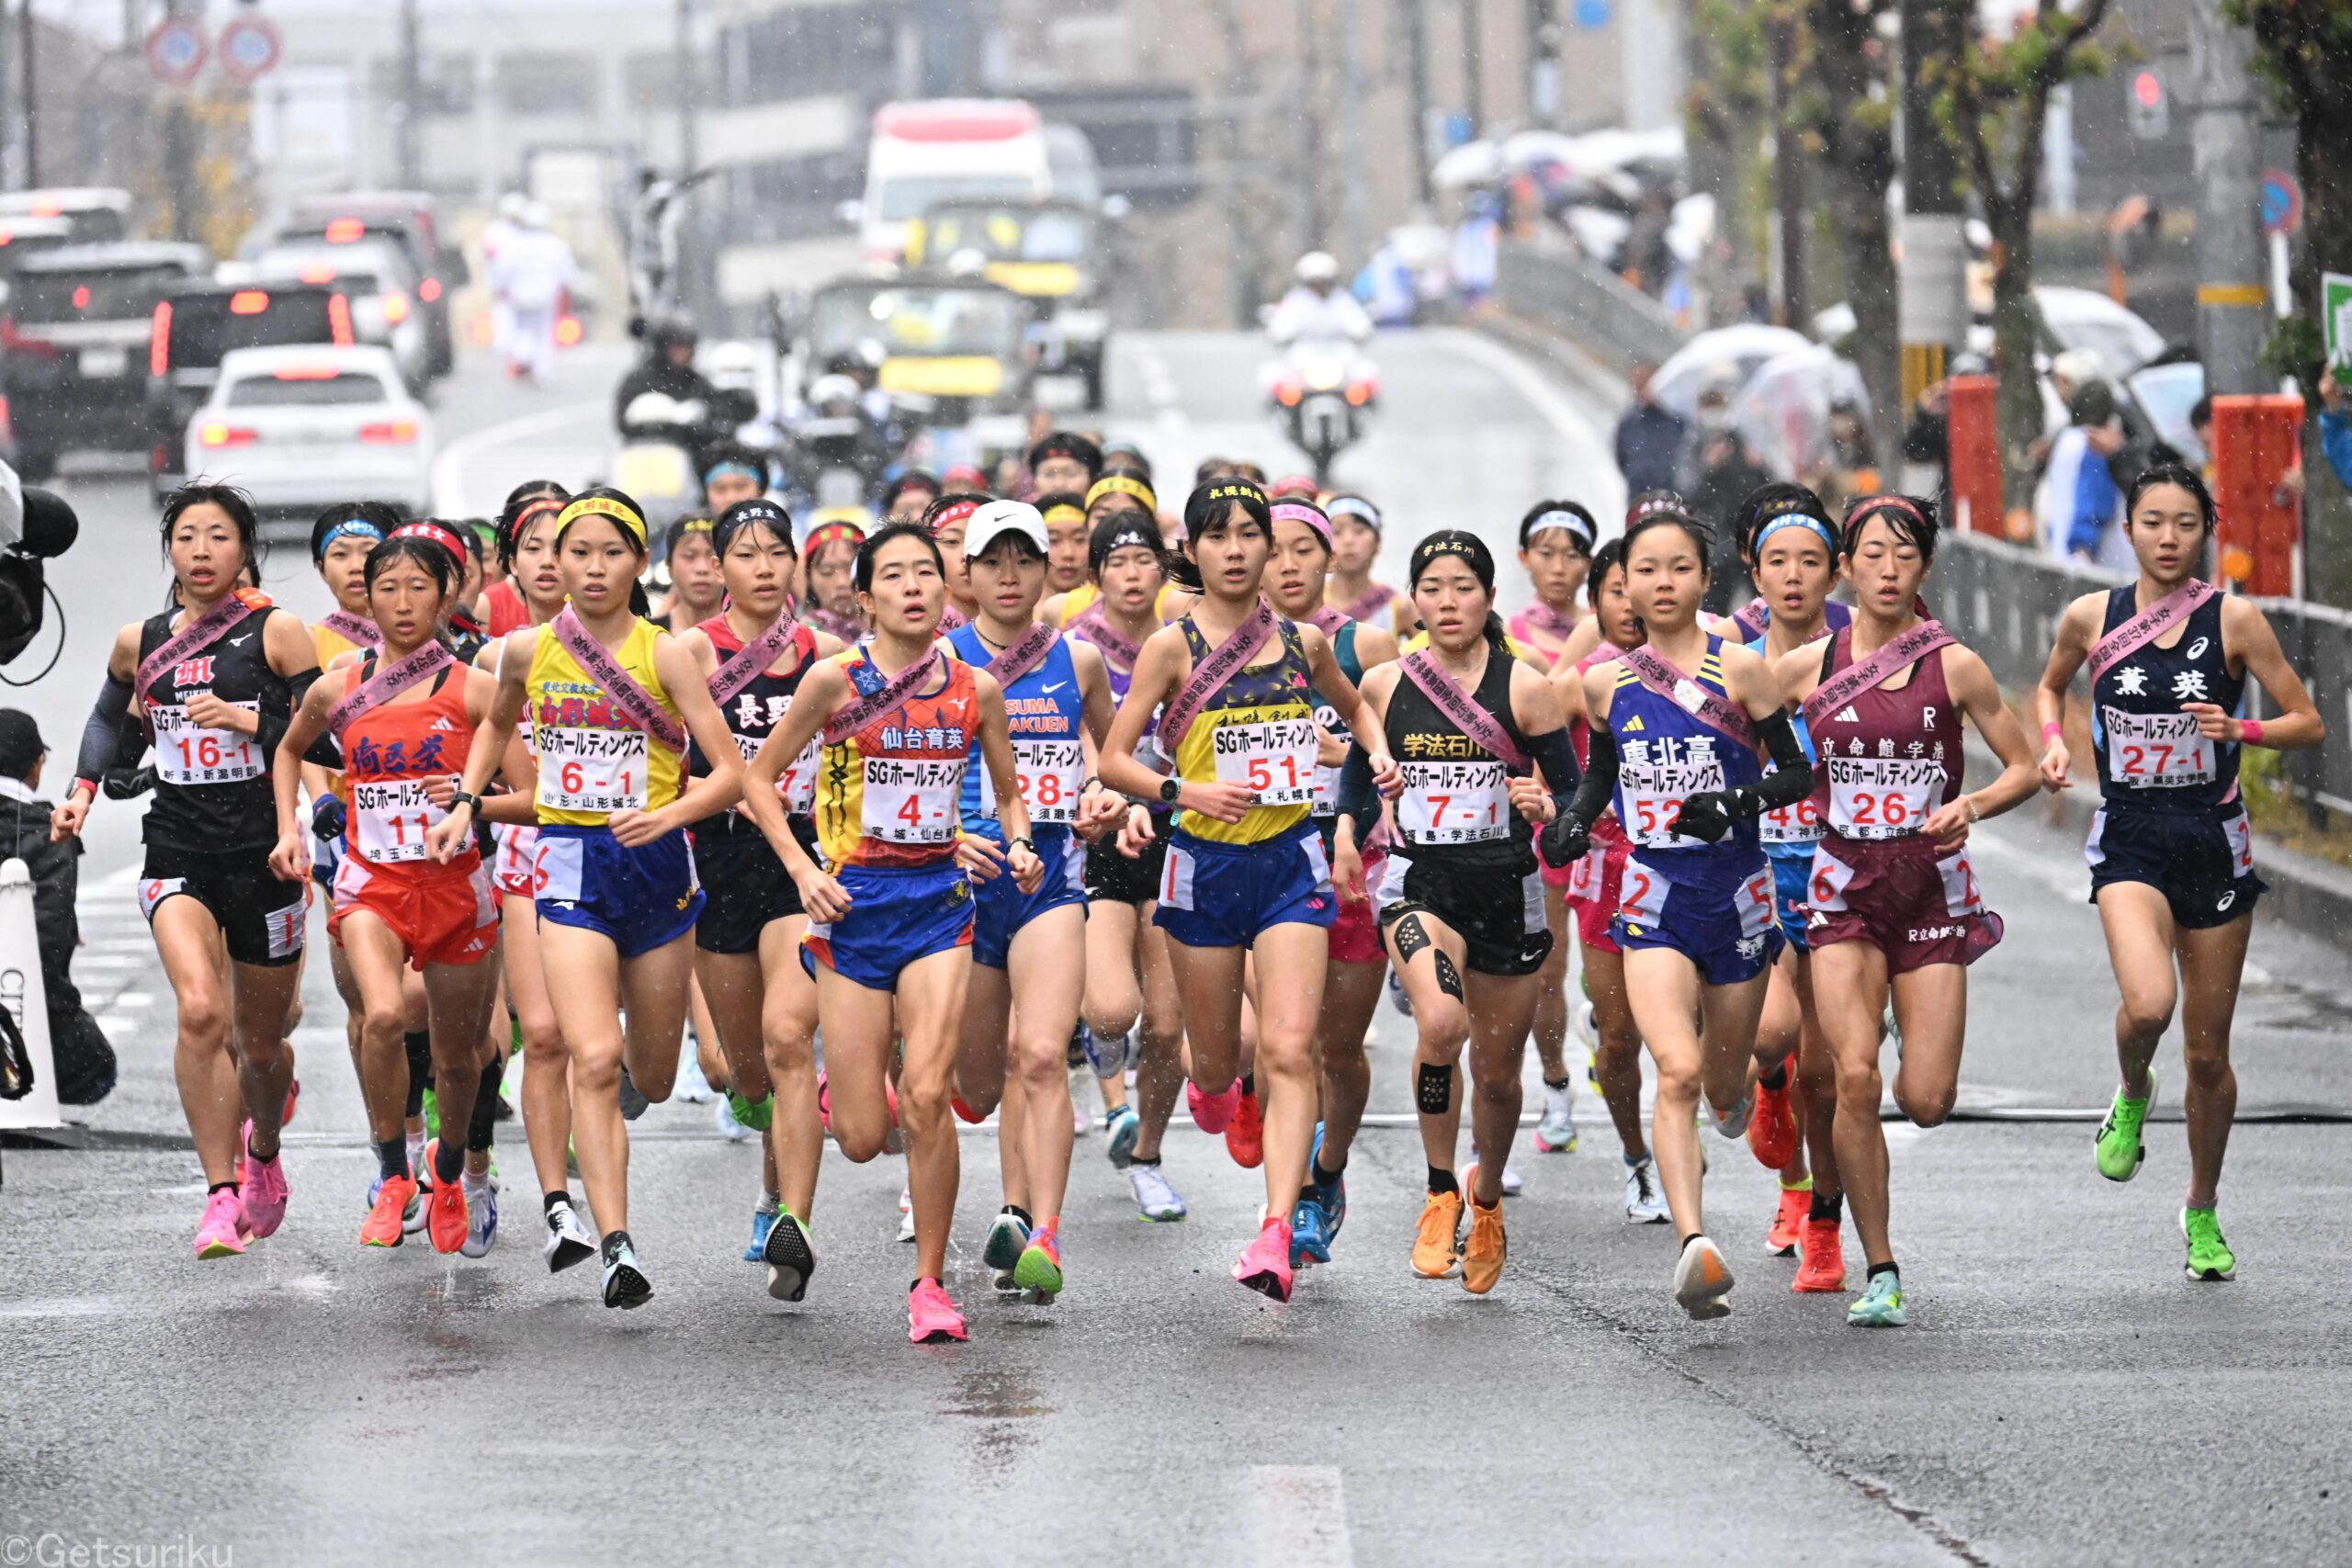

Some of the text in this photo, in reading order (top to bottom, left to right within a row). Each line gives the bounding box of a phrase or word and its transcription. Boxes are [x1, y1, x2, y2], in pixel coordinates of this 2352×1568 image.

[571, 501, 626, 516] 山形城北
[1423, 540, 1475, 558] 学法石川
[1004, 698, 1059, 716] SUMA
[1924, 706, 1937, 731] R
[175, 734, 250, 770] 16-1
[538, 728, 646, 758] SGホールディングス
[880, 727, 965, 750] 仙台育英
[1403, 732, 1492, 758] 学法石川
[1622, 735, 1717, 766] 東北高
[2122, 744, 2204, 774] 27-1
[561, 761, 632, 795] 6-1
[1426, 795, 1497, 829] 7-1
[1621, 873, 1650, 918] 2
[1814, 865, 1835, 903] 6
[1748, 876, 1773, 923] 5
